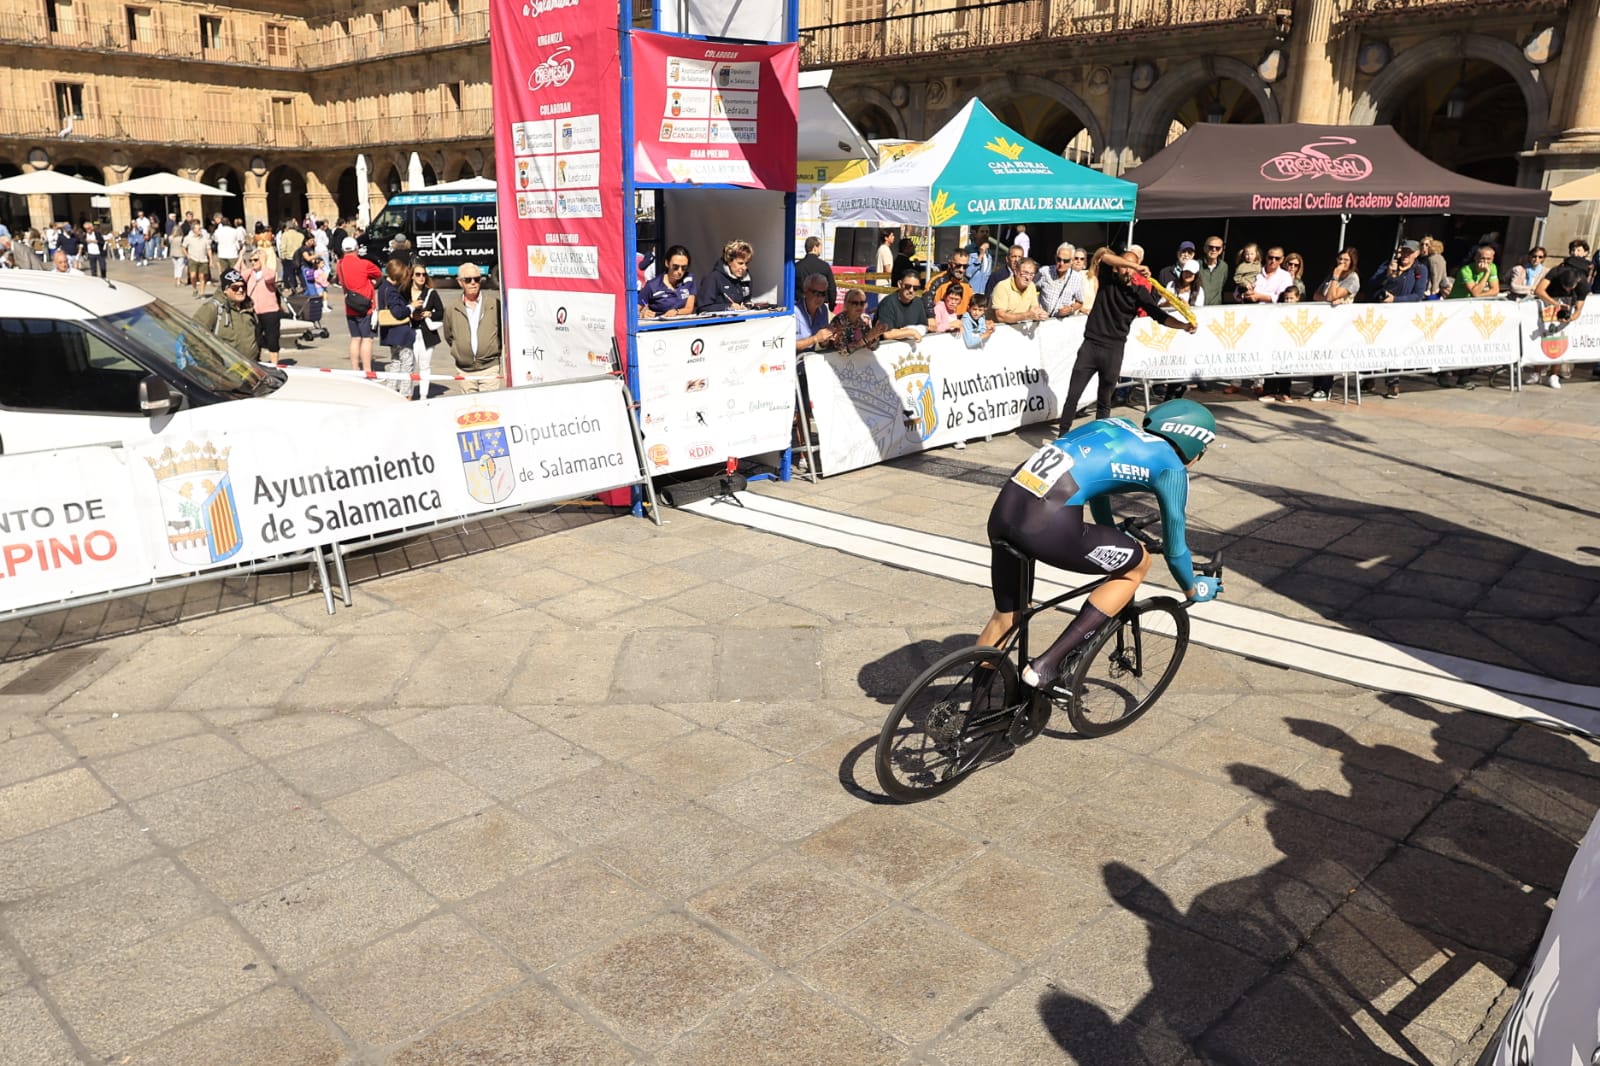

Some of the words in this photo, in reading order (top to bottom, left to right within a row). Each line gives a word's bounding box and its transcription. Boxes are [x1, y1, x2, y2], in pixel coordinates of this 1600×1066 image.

[988, 161, 1014, 169] CAJA
[1013, 161, 1049, 169] RURAL
[880, 199, 921, 213] SALAMANCA
[967, 199, 996, 215] CAJA
[998, 198, 1037, 211] RURAL
[1038, 197, 1054, 210] DE
[1055, 197, 1125, 211] SALAMANCA
[1252, 193, 1303, 210] Promesal
[1305, 192, 1343, 209] Cycling
[1345, 192, 1393, 208] Academy
[1395, 192, 1450, 208] Salamanca
[464, 248, 494, 256] TEAM
[1195, 353, 1222, 367] CAJA
[942, 366, 1040, 401] Ayuntamiento
[947, 406, 963, 429] de
[967, 393, 1044, 424] Salamanca
[510, 414, 601, 447] Diputación
[1160, 422, 1216, 444] GIANT
[519, 466, 534, 482] de
[540, 450, 624, 479] Salamanca
[1031, 449, 1064, 480] 82
[1111, 462, 1150, 478] KERN
[253, 451, 435, 509] Ayuntamiento
[63, 498, 107, 524] DE
[261, 513, 297, 544] de
[308, 488, 442, 534] Salamanca
